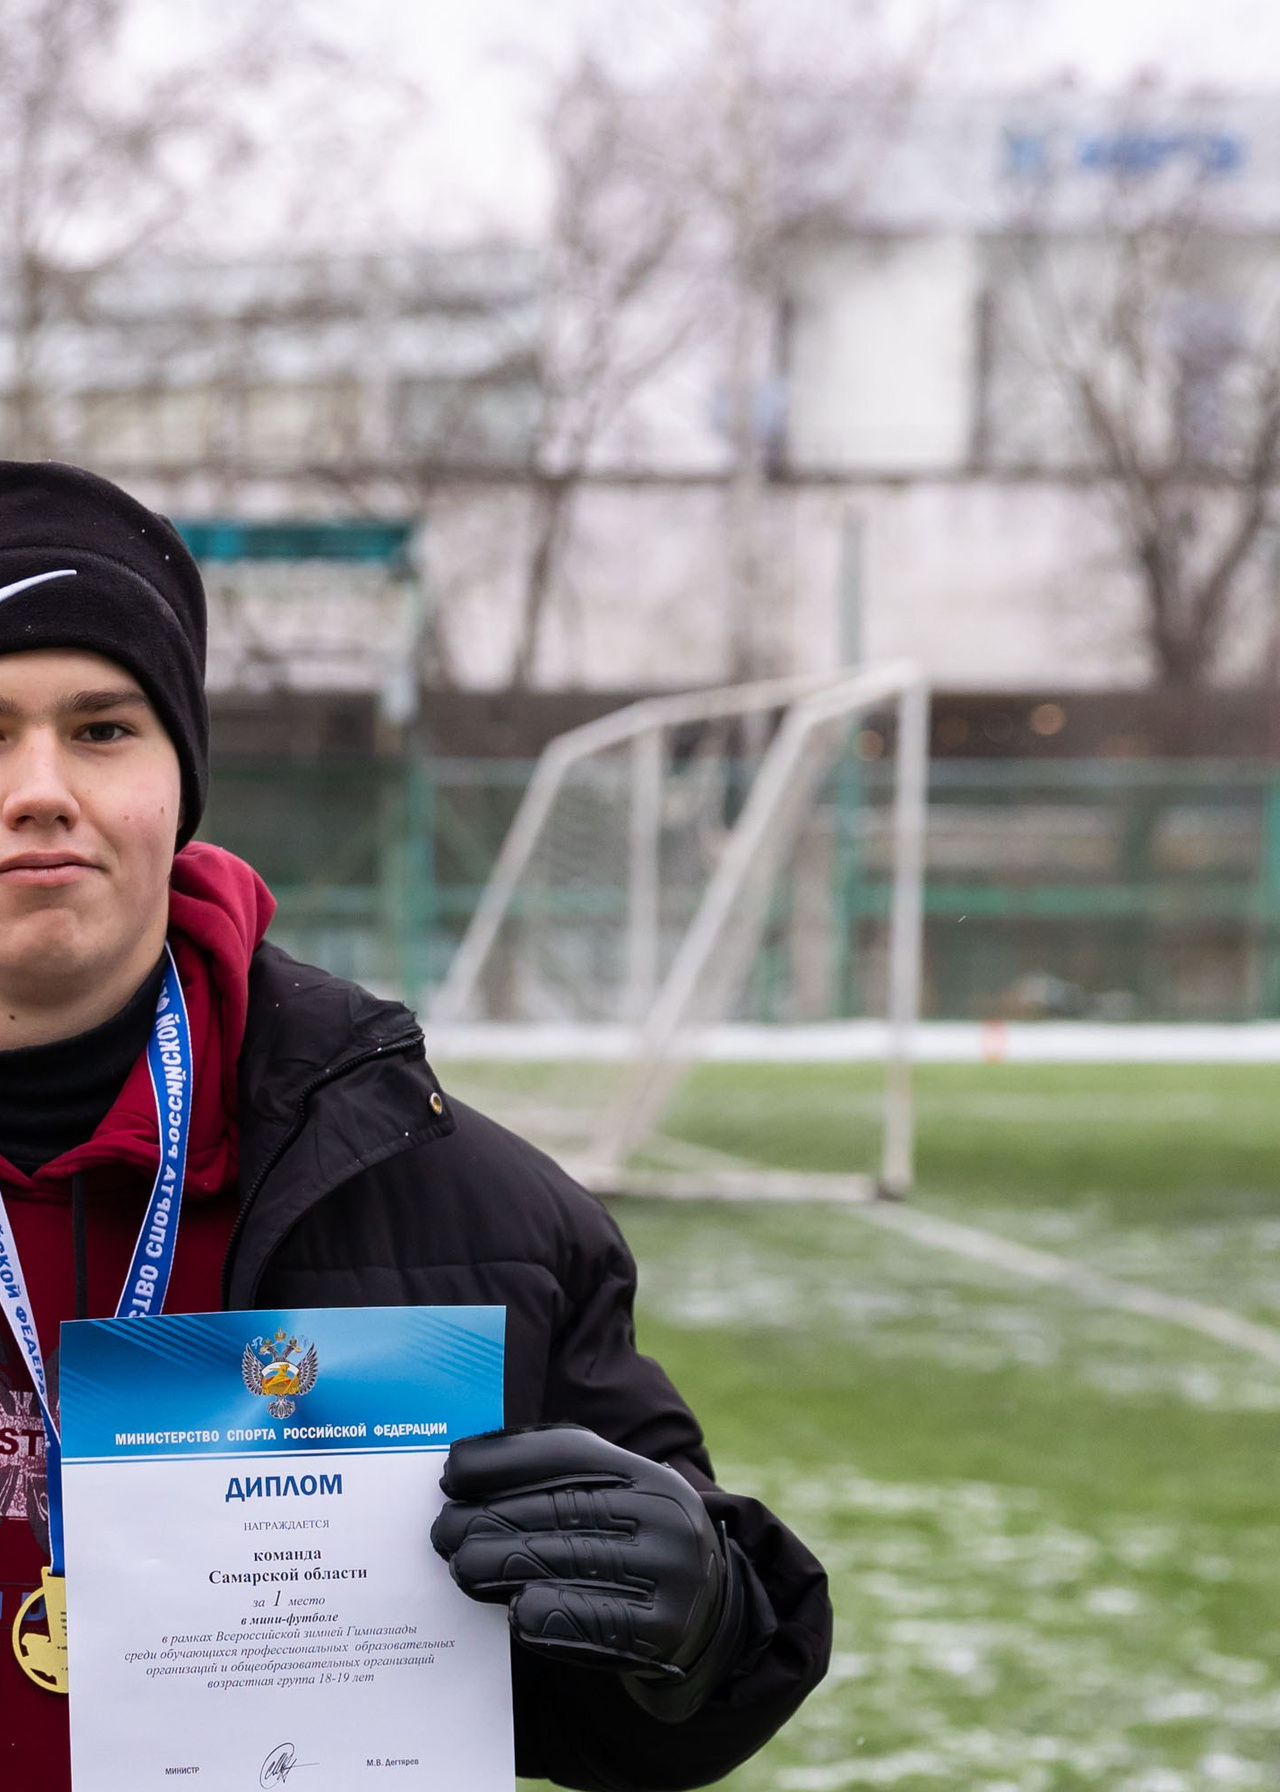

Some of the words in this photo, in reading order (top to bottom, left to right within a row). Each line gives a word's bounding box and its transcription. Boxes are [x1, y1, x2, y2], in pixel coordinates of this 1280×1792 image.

[116, 1429, 220, 1446] МИНИСТЕРСТВО
[227, 1428, 277, 1442] СПОРТА
[284, 1423, 367, 1439] РОССИЙСКОЙ
[374, 1423, 448, 1437] ФЕДЕРАЦИИ
[226, 1474, 343, 1502] ДИПЛОМ
[244, 1519, 330, 1531] НАГРАЖДАЕТСЯ
[254, 1548, 321, 1563] команда
[209, 1568, 299, 1585] Самарской
[304, 1566, 368, 1581] области
[253, 1599, 265, 1608] за
[288, 1597, 325, 1607] место
[242, 1617, 247, 1625] в
[250, 1612, 339, 1628] мини-футболе
[170, 1634, 212, 1646] рамках
[216, 1629, 300, 1642] Всероссийской
[304, 1627, 344, 1638] зимней
[346, 1624, 417, 1637] Гимназиады
[124, 1650, 157, 1662] среди
[160, 1645, 237, 1661] обучающихся
[240, 1644, 348, 1658] профессиональных
[354, 1640, 455, 1653] образовательных
[146, 1662, 217, 1678] организаций
[230, 1658, 360, 1675] общеобразовательных
[363, 1654, 435, 1669] организаций
[207, 1677, 274, 1689] возрастная
[276, 1676, 316, 1688] группа
[318, 1671, 349, 1684] 18-19
[352, 1674, 374, 1683] лет
[165, 1766, 199, 1775] МИНИСТР
[366, 1758, 383, 1767] М.В.
[385, 1758, 419, 1767] Дегтярев
